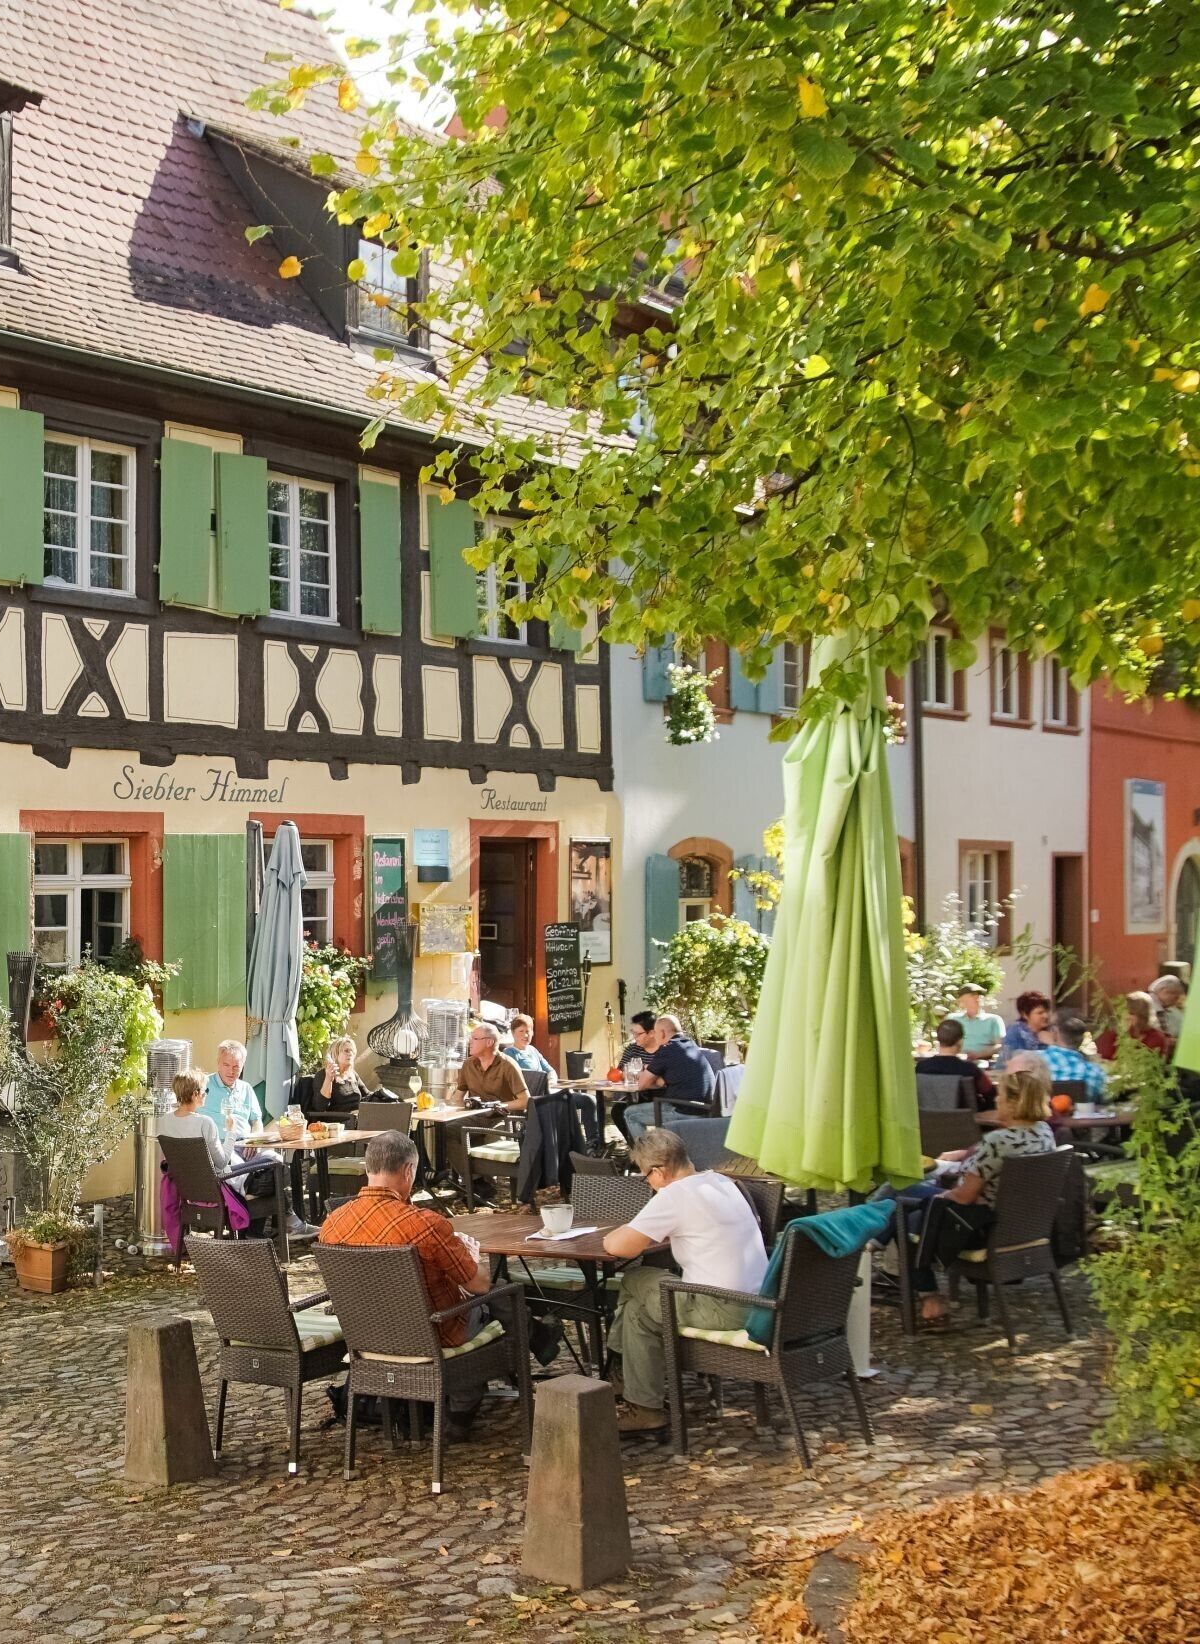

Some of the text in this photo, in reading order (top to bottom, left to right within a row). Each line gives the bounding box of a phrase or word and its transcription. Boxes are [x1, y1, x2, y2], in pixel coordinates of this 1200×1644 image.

[113, 765, 289, 803] Siebter Himmel
[480, 788, 548, 811] Restaurant
[546, 968, 577, 978] Sonntag
